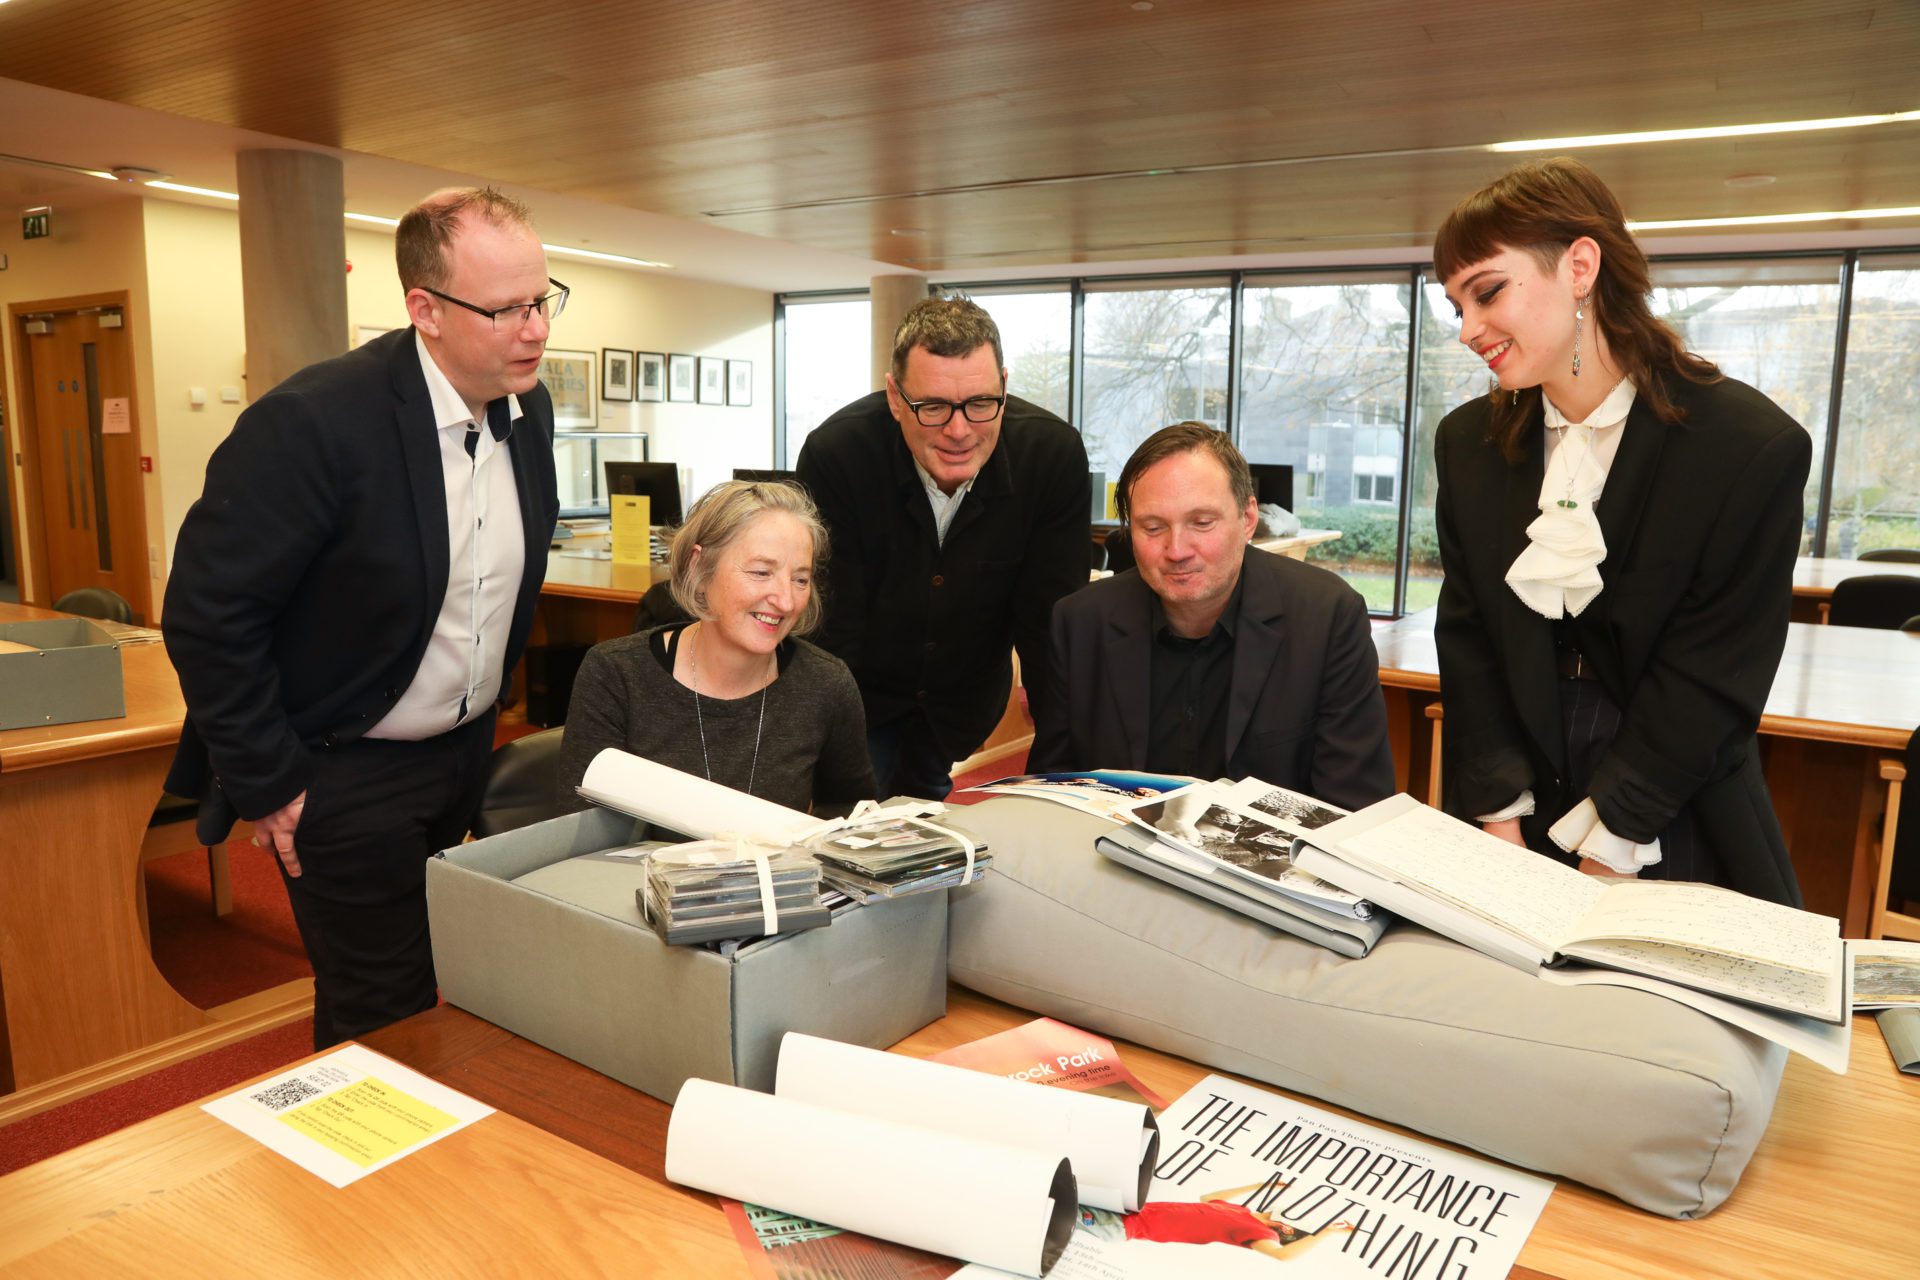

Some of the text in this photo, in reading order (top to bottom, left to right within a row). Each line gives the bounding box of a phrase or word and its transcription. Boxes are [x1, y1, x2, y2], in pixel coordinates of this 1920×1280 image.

[1047, 1069, 1088, 1085] evening
[1087, 1064, 1111, 1075] time
[1056, 1047, 1104, 1071] Park
[1297, 1116, 1431, 1163] Pan Pan Theatre presents
[1153, 1140, 1230, 1186] OF
[1181, 1093, 1520, 1237] THE IMPORTANCE
